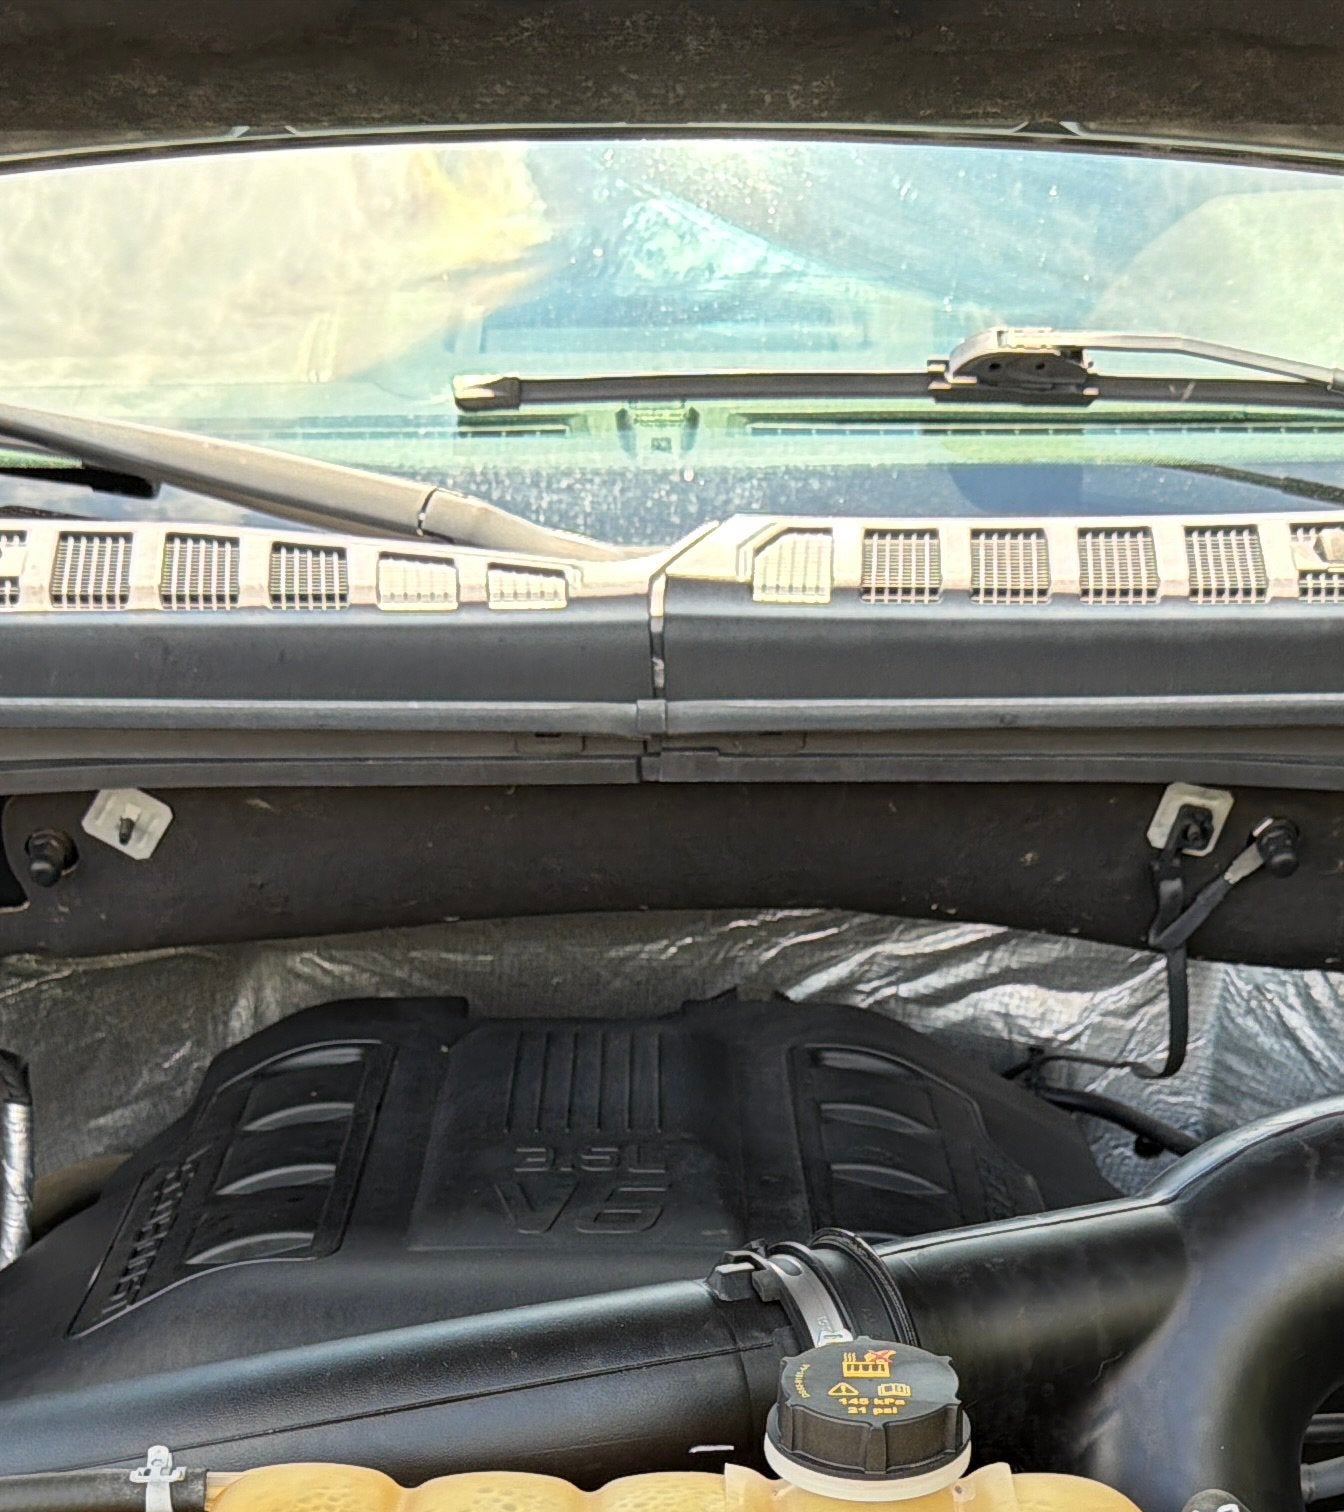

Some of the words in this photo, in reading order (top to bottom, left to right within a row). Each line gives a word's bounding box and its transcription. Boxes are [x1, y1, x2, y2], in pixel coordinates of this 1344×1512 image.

[513, 1146, 666, 1173] 3.5L
[494, 1181, 666, 1234] V6
[838, 1398, 869, 1406] 145
[873, 1397, 906, 1406] kPa
[847, 1406, 867, 1414] 21
[873, 1406, 898, 1416] psi
